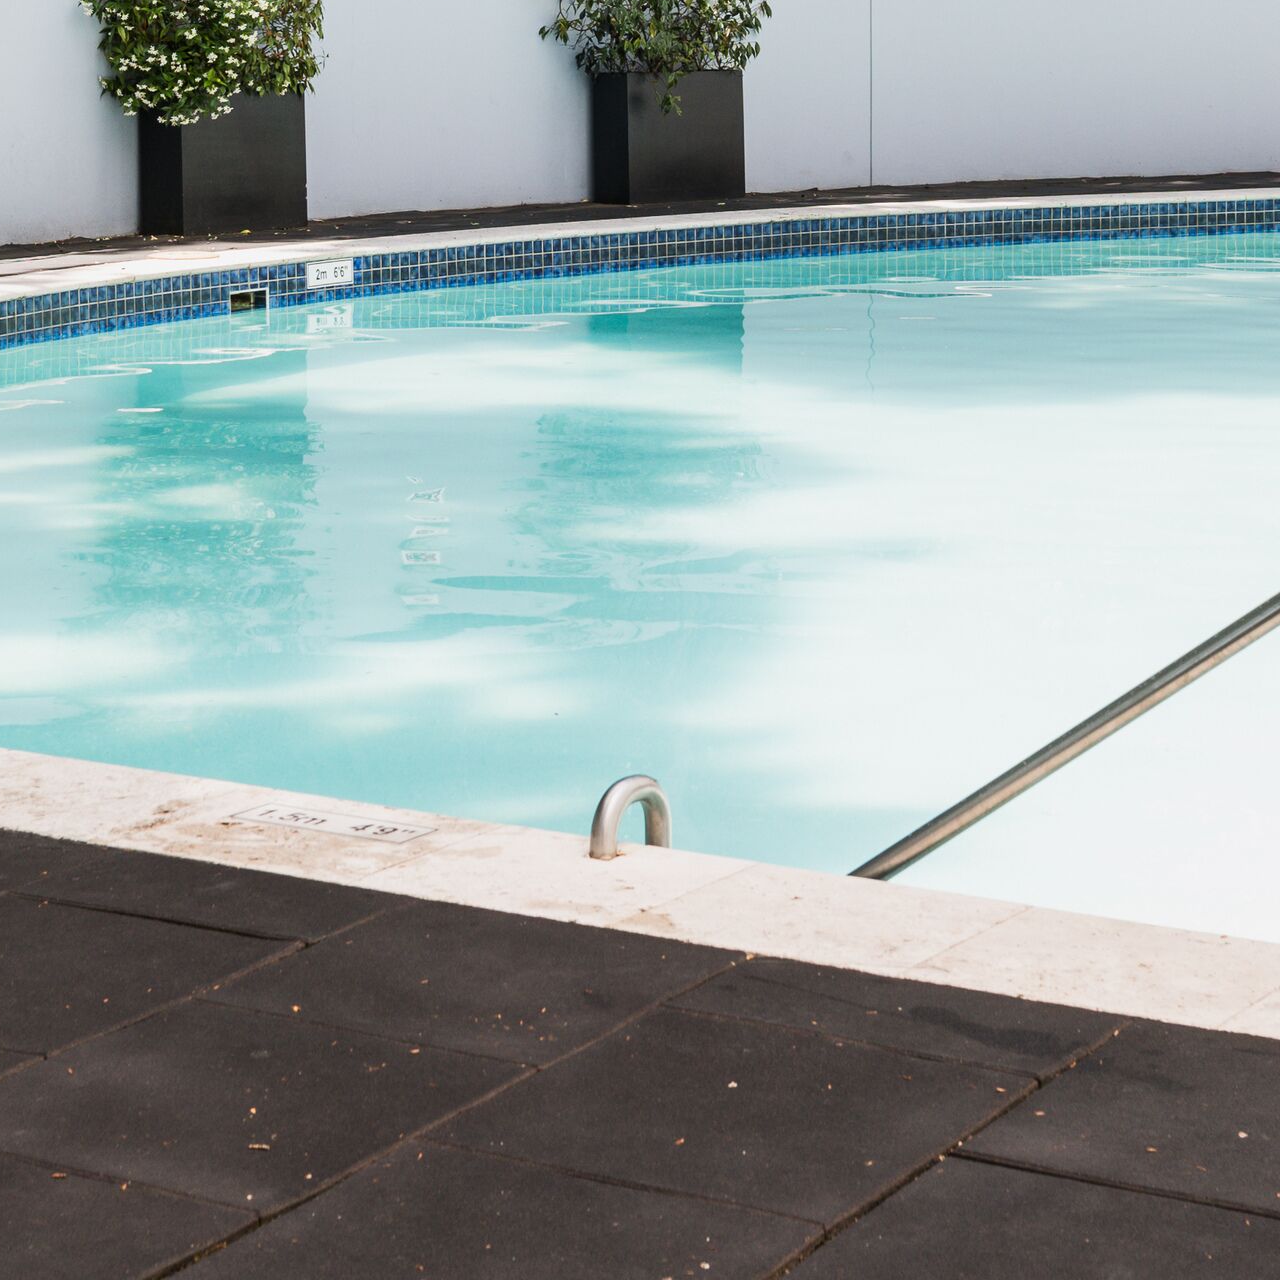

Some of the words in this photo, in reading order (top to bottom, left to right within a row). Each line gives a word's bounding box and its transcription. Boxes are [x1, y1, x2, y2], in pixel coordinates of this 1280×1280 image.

[316, 268, 328, 281] 2m
[333, 265, 348, 279] 6'6"
[258, 809, 327, 826] 1.5m
[350, 823, 416, 836] 4'9"
